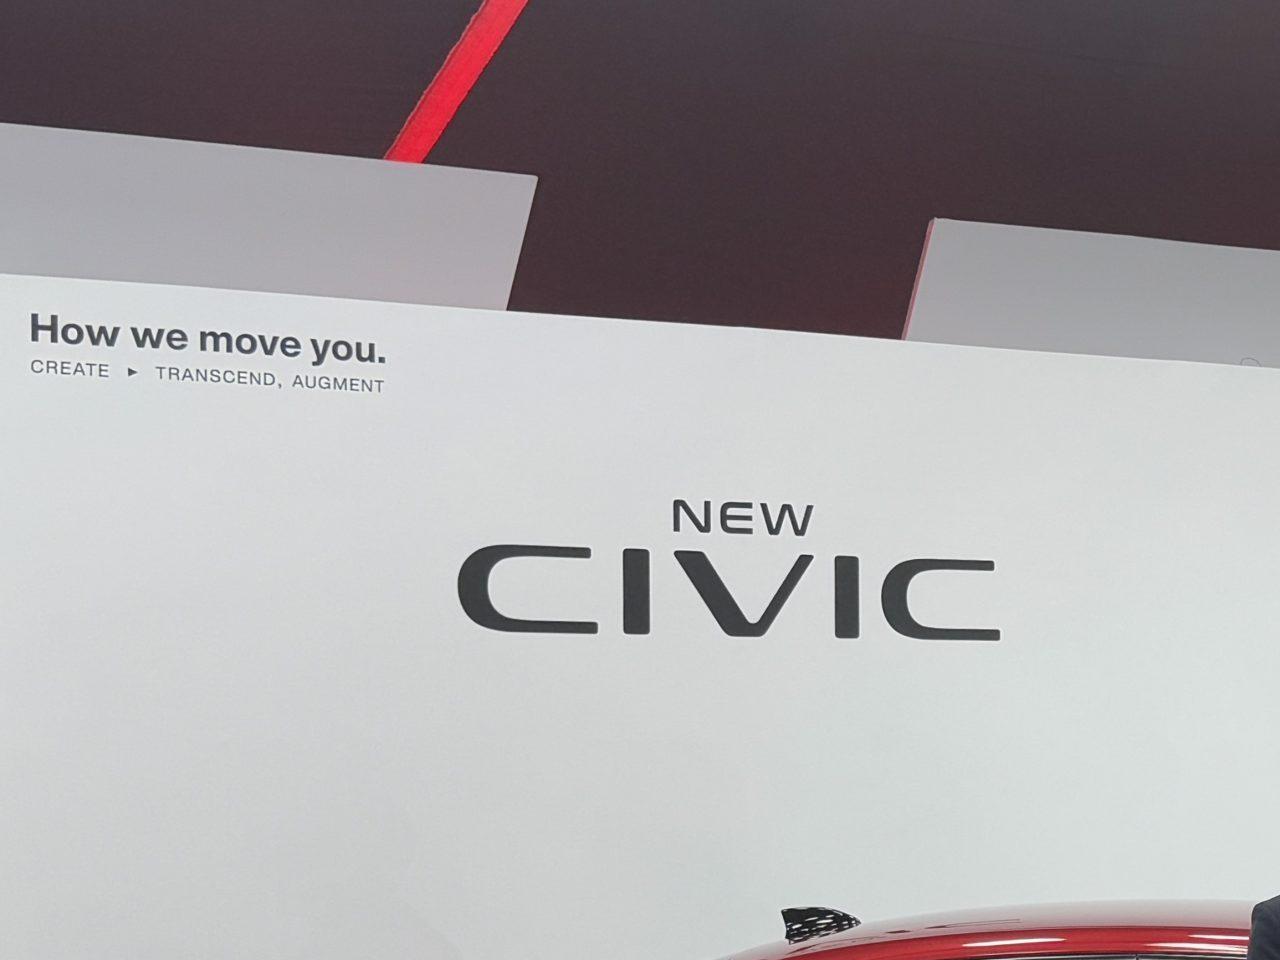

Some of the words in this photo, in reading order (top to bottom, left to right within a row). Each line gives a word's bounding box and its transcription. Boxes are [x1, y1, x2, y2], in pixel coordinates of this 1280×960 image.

[30, 312, 121, 347] How
[130, 326, 189, 351] we
[199, 330, 302, 358] move
[309, 338, 386, 367] you.
[30, 359, 109, 378] CREATE
[155, 366, 282, 389] TRANSCEND,
[291, 374, 385, 393] AUGMENT
[672, 499, 814, 537] NEW
[457, 544, 1001, 642] CIVIC
